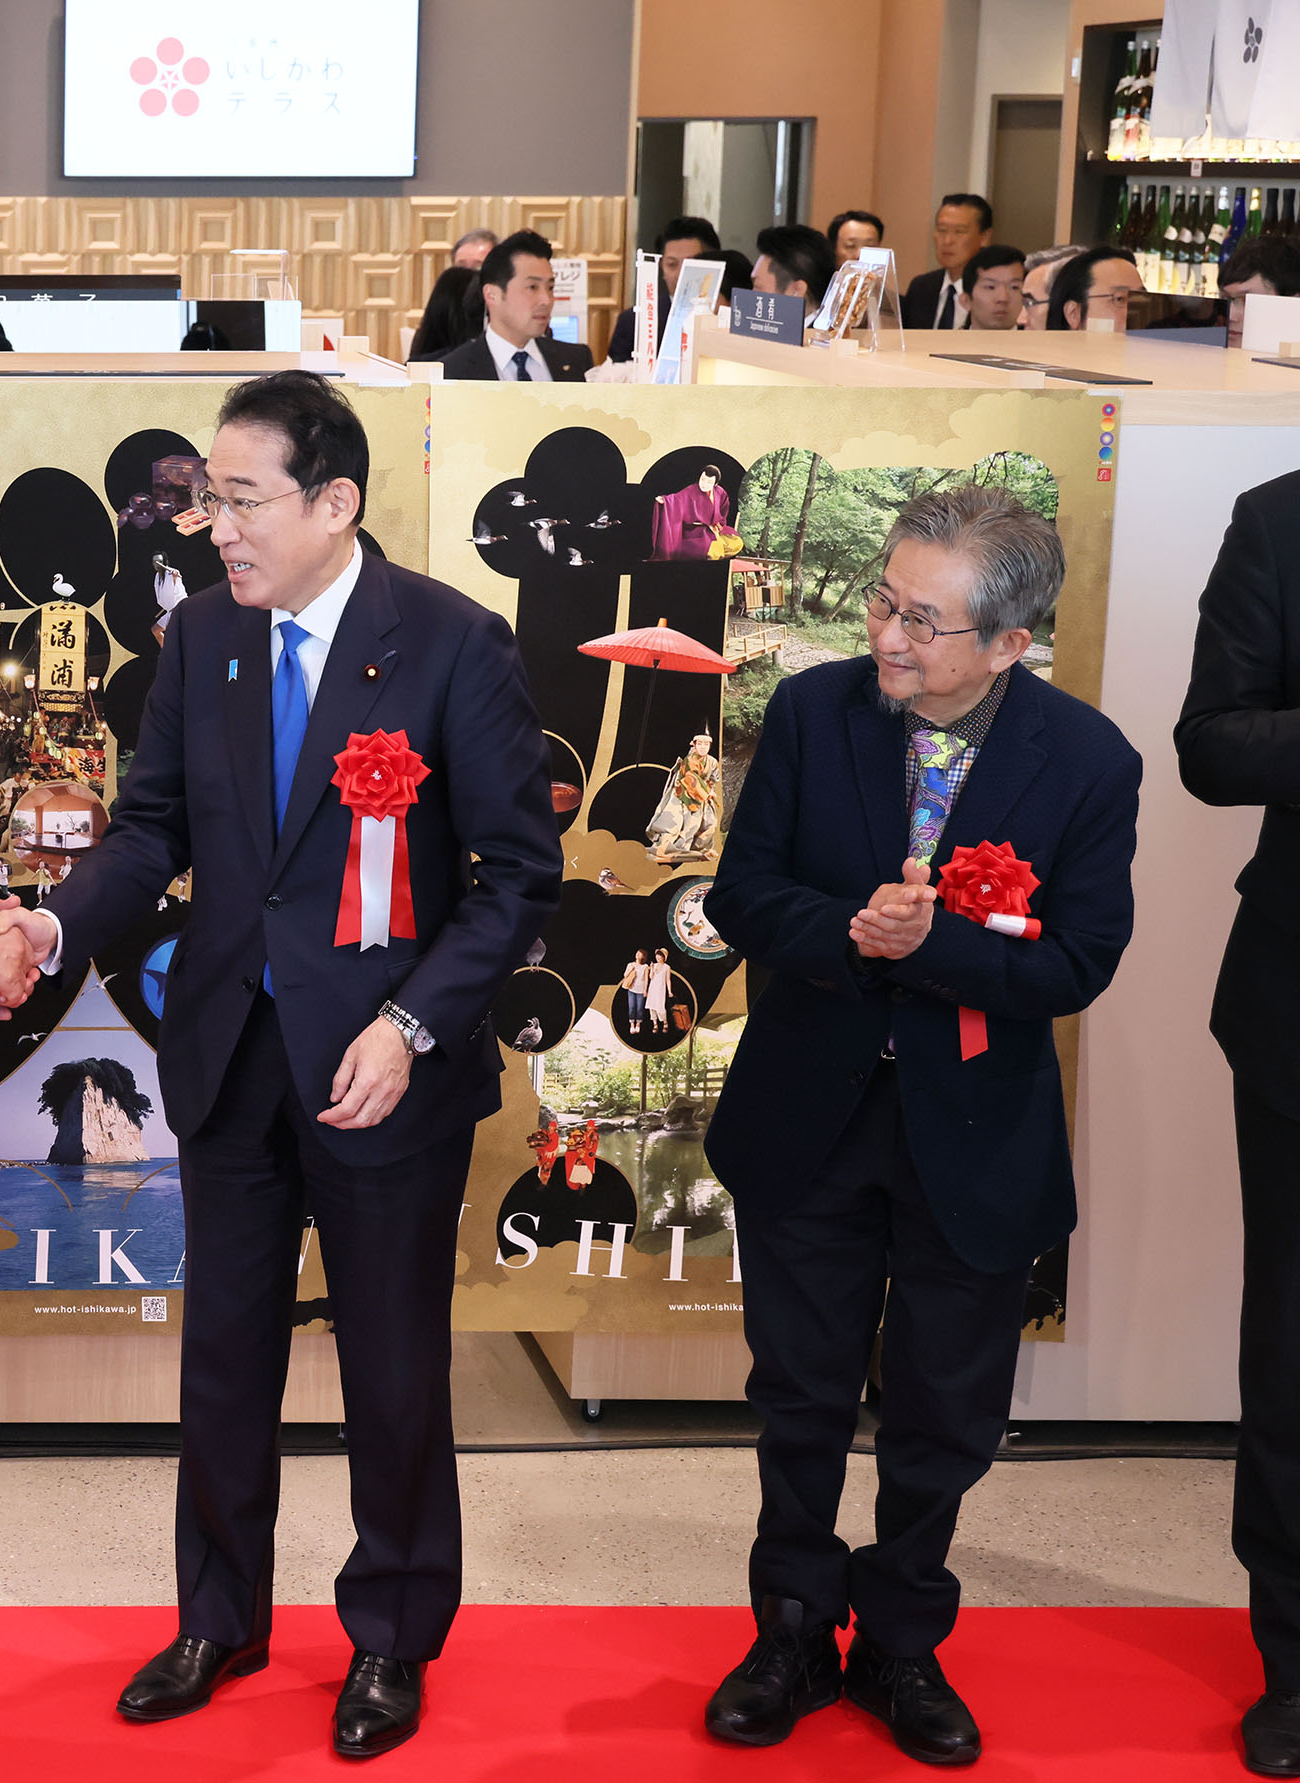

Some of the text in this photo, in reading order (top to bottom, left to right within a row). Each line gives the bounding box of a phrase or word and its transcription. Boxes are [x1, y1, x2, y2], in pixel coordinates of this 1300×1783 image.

[225, 55, 345, 81] いしかわ
[227, 91, 341, 116] テラス
[33, 1303, 137, 1315] www.hot-ishikawa.jp
